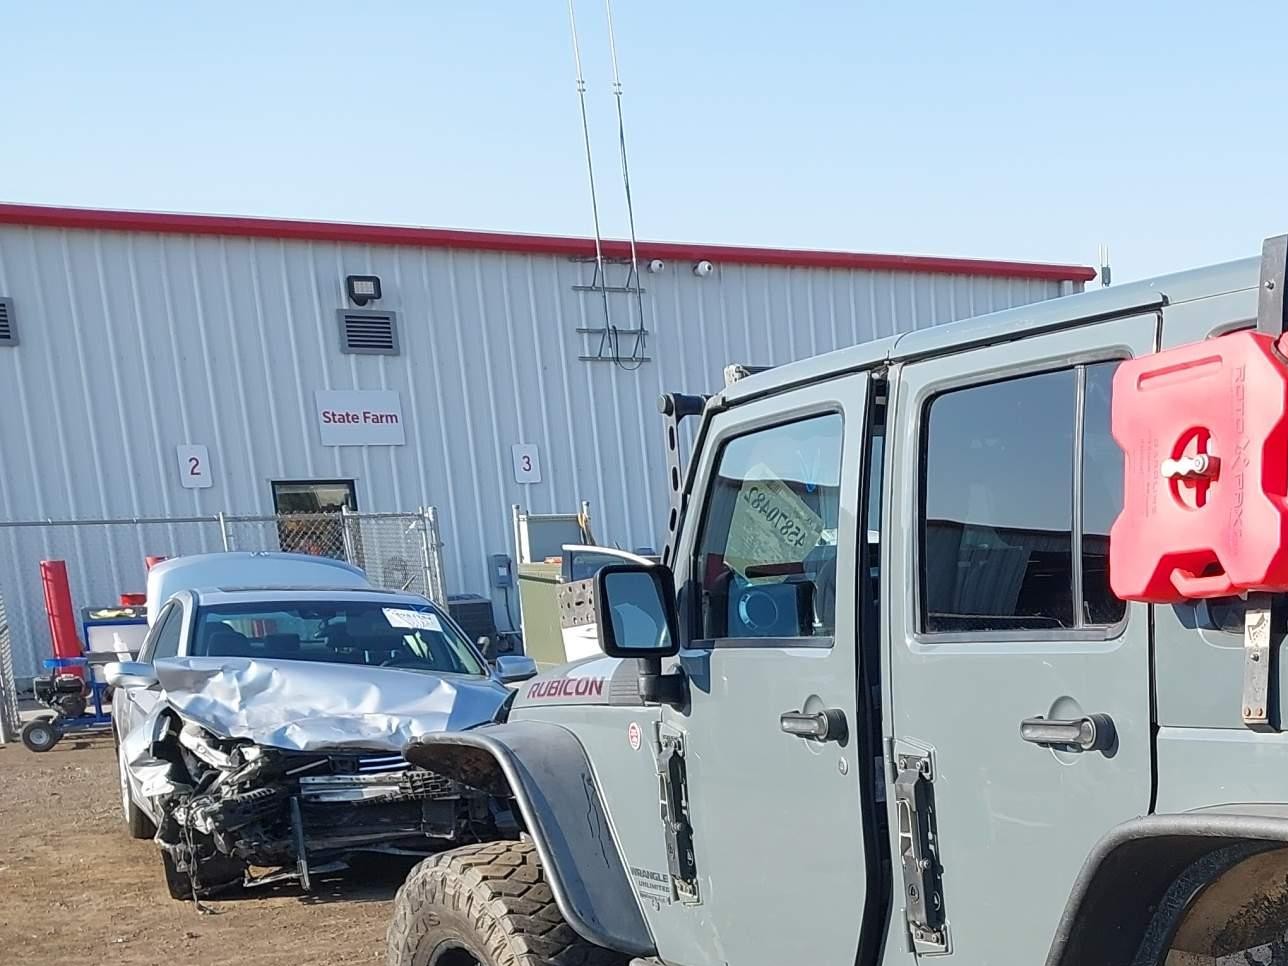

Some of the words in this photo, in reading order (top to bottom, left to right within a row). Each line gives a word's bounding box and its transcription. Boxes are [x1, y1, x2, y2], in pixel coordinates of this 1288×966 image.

[322, 411, 360, 424] State
[362, 411, 399, 424] Farm
[188, 456, 201, 475] 2
[522, 455, 532, 471] 3
[527, 678, 604, 699] RUBICON
